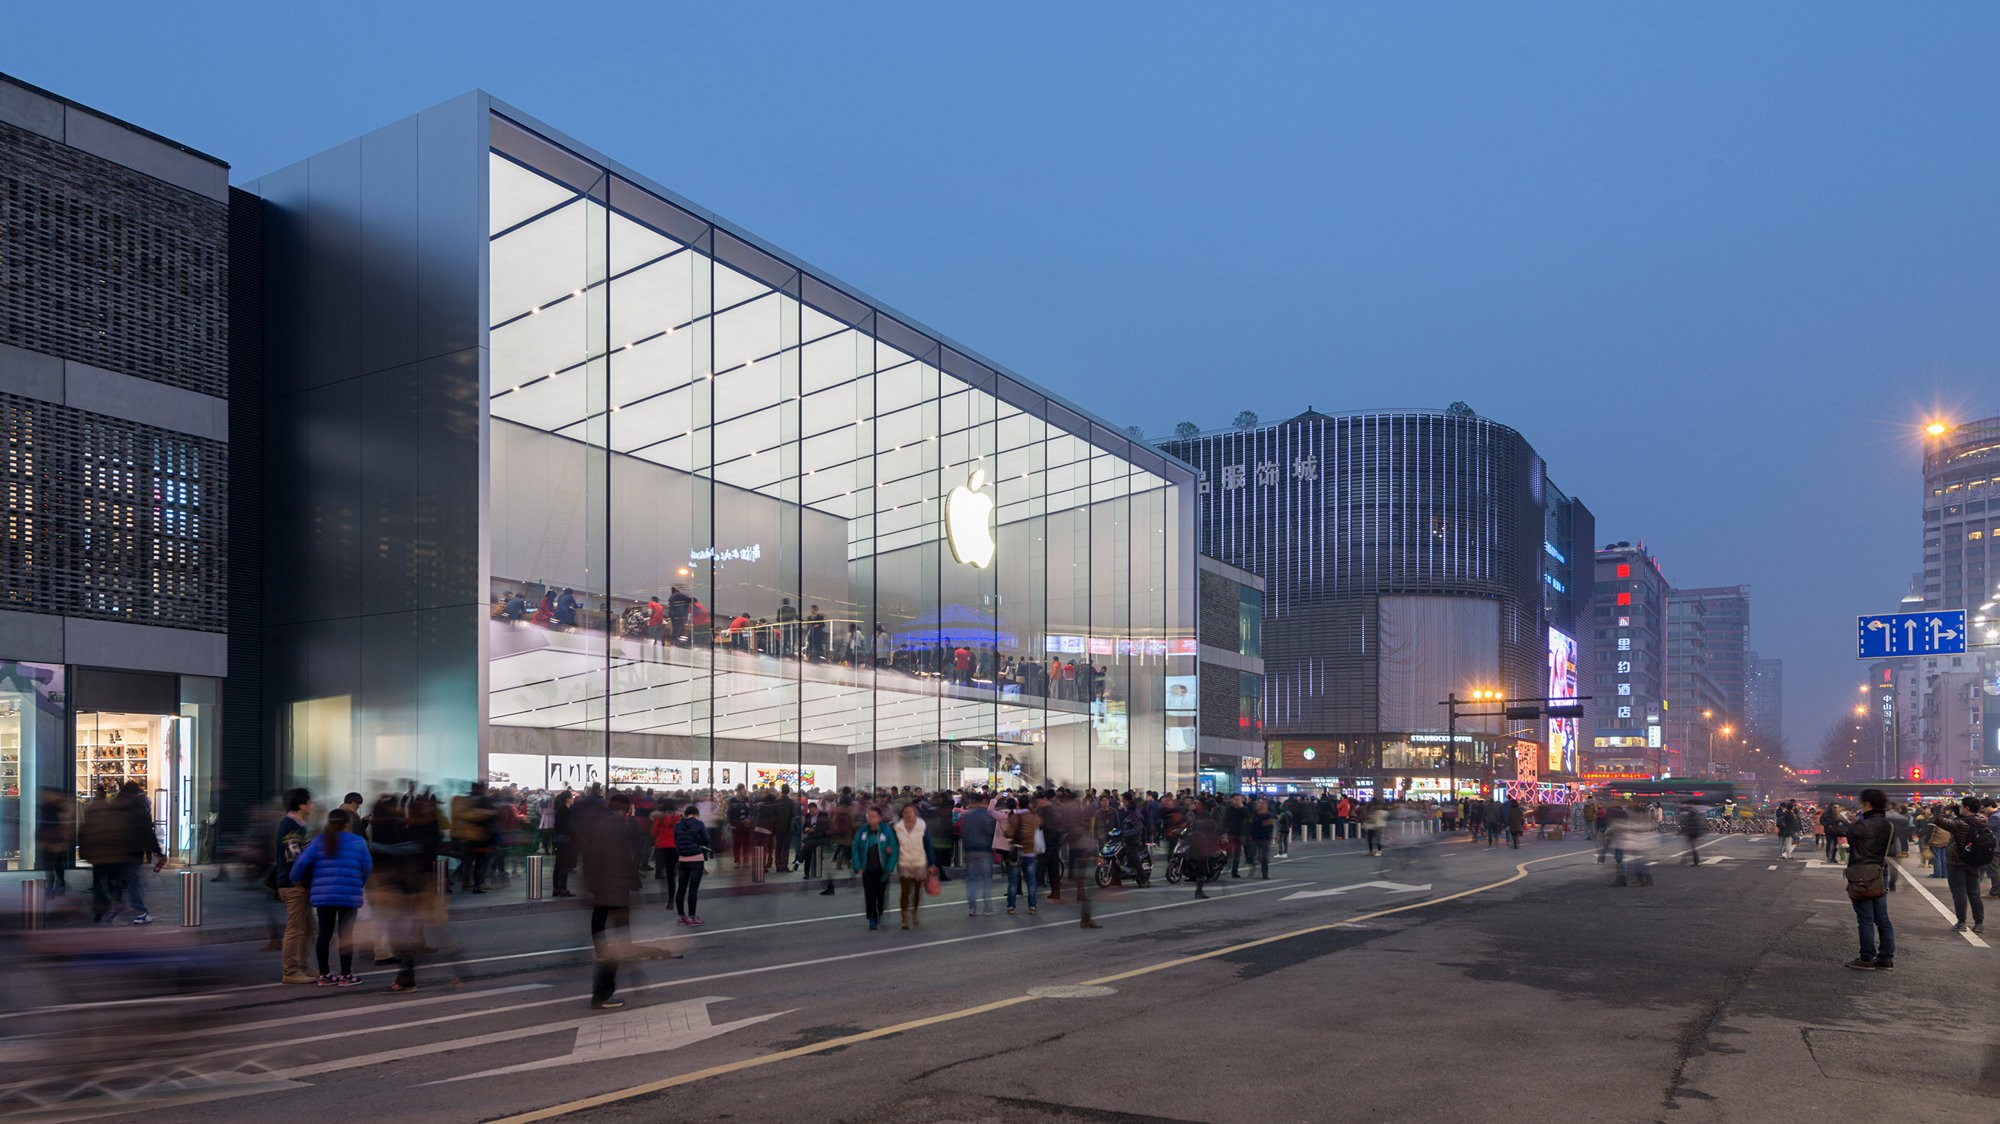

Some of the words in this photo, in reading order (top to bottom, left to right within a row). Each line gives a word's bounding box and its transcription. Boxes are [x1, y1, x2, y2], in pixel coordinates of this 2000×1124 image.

[1617, 637, 1631, 719] 里约酒店
[1410, 734, 1451, 743] STARBUCKS
[1453, 735, 1473, 743] OFFEE
